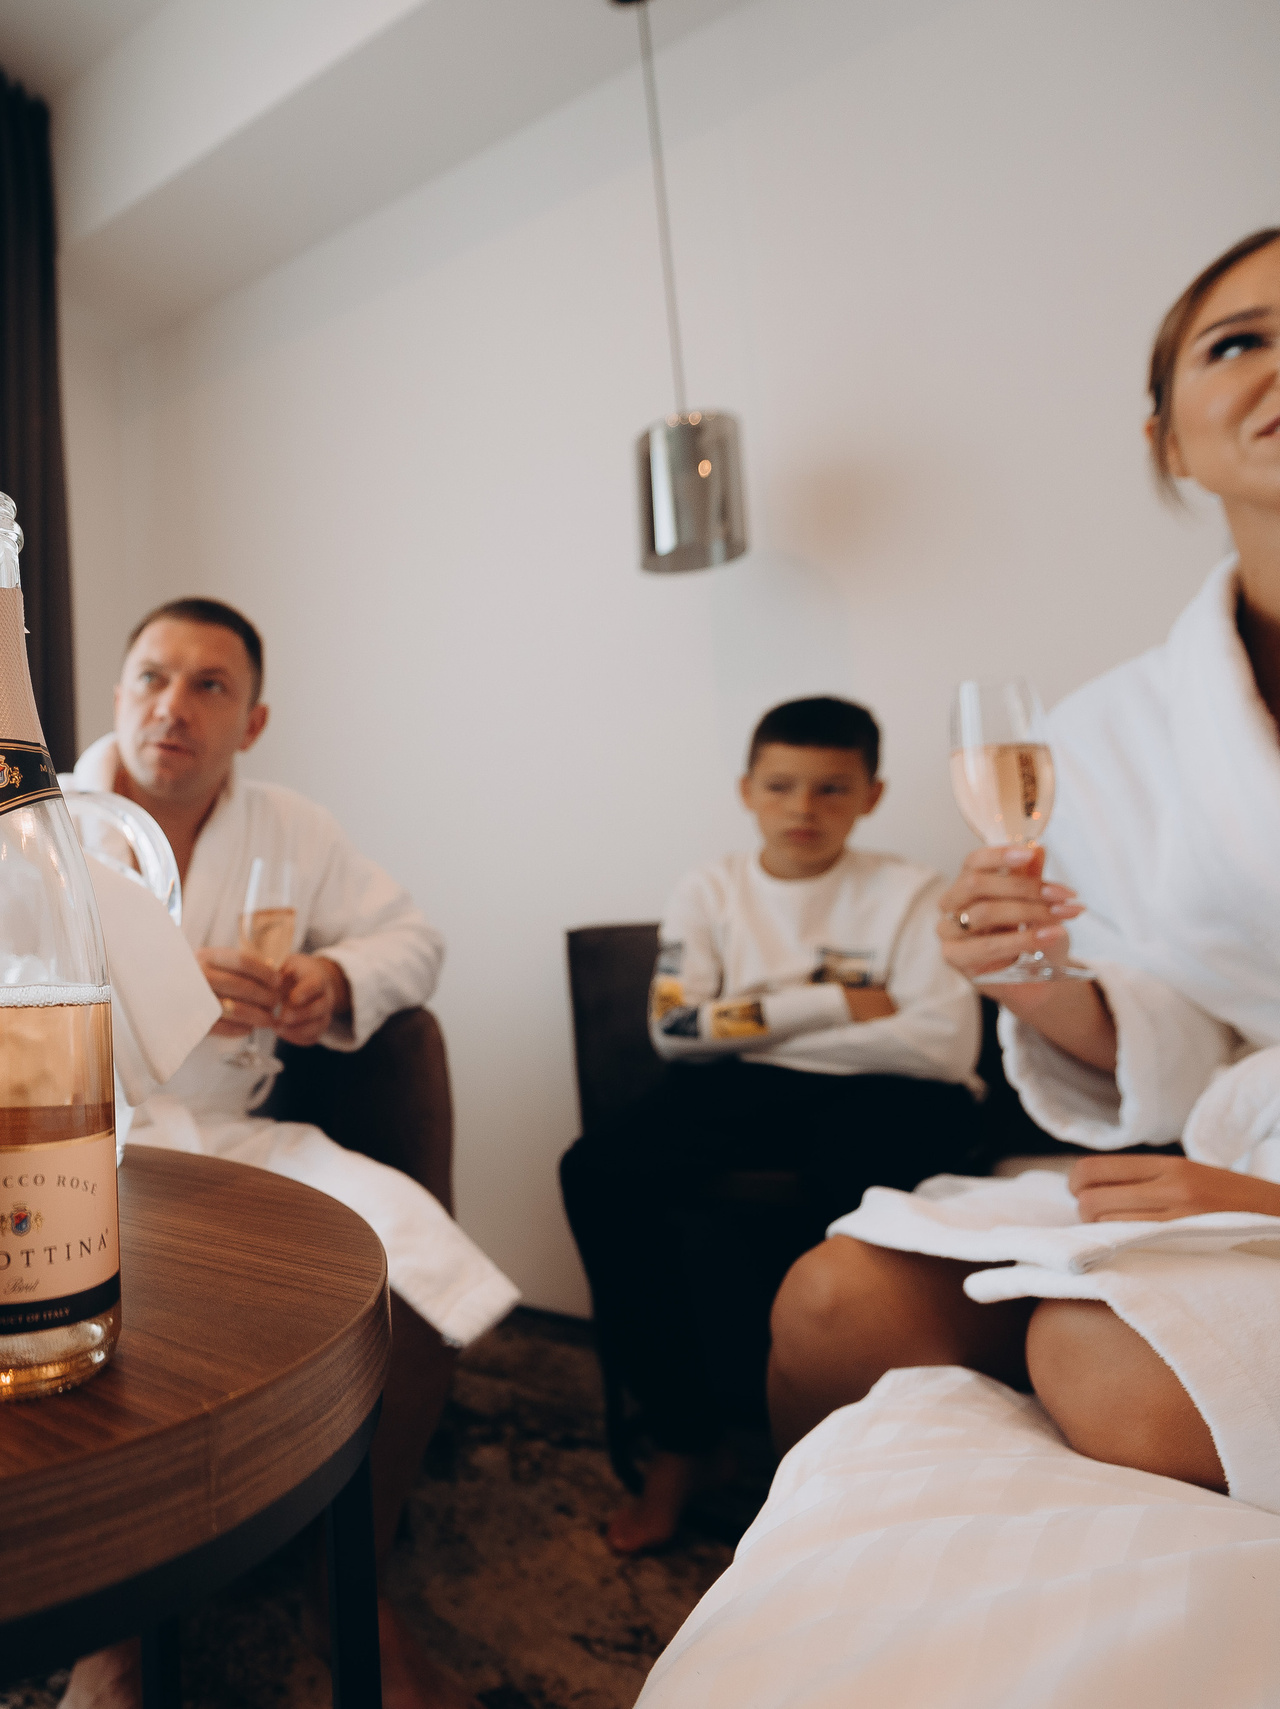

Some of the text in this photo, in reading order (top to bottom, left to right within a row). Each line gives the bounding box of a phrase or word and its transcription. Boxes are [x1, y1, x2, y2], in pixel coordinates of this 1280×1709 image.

[2, 1276, 40, 1294] Brut
[25, 1312, 40, 1323] OF
[42, 1307, 71, 1321] ITALY
